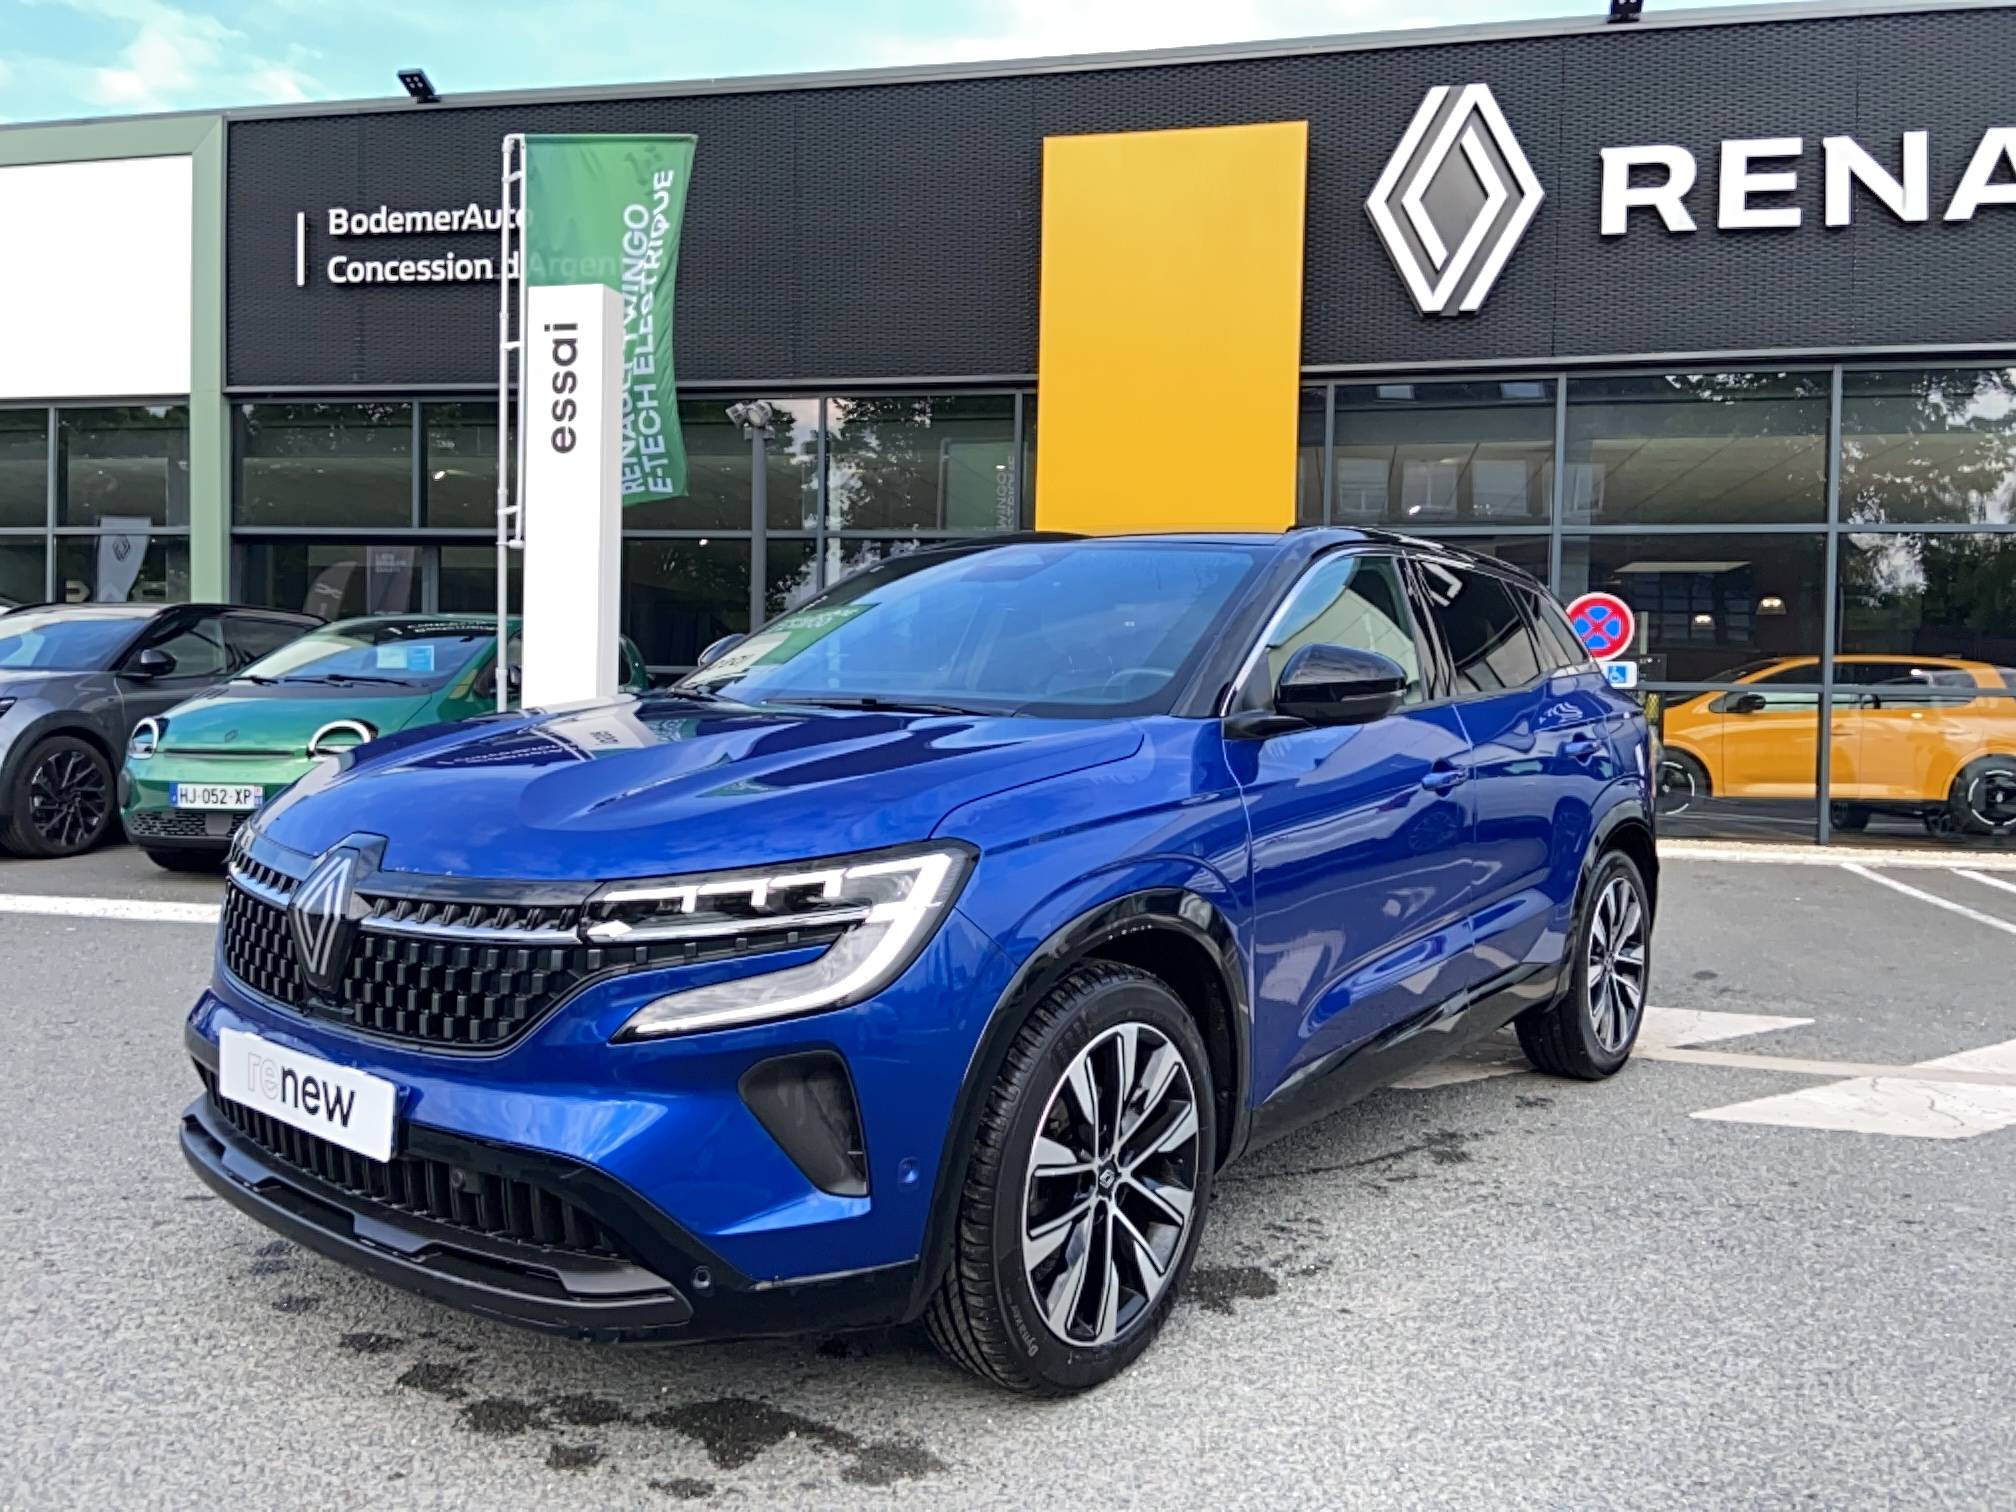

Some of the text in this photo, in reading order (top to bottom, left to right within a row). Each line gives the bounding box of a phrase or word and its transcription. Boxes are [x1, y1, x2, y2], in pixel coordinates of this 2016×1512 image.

[328, 203, 533, 236] BodemerAuto
[1600, 127, 2016, 236] RENA
[327, 252, 494, 283] Concession
[544, 323, 578, 454] essai
[633, 383, 673, 493] E-TECH
[248, 1052, 356, 1127] renew
